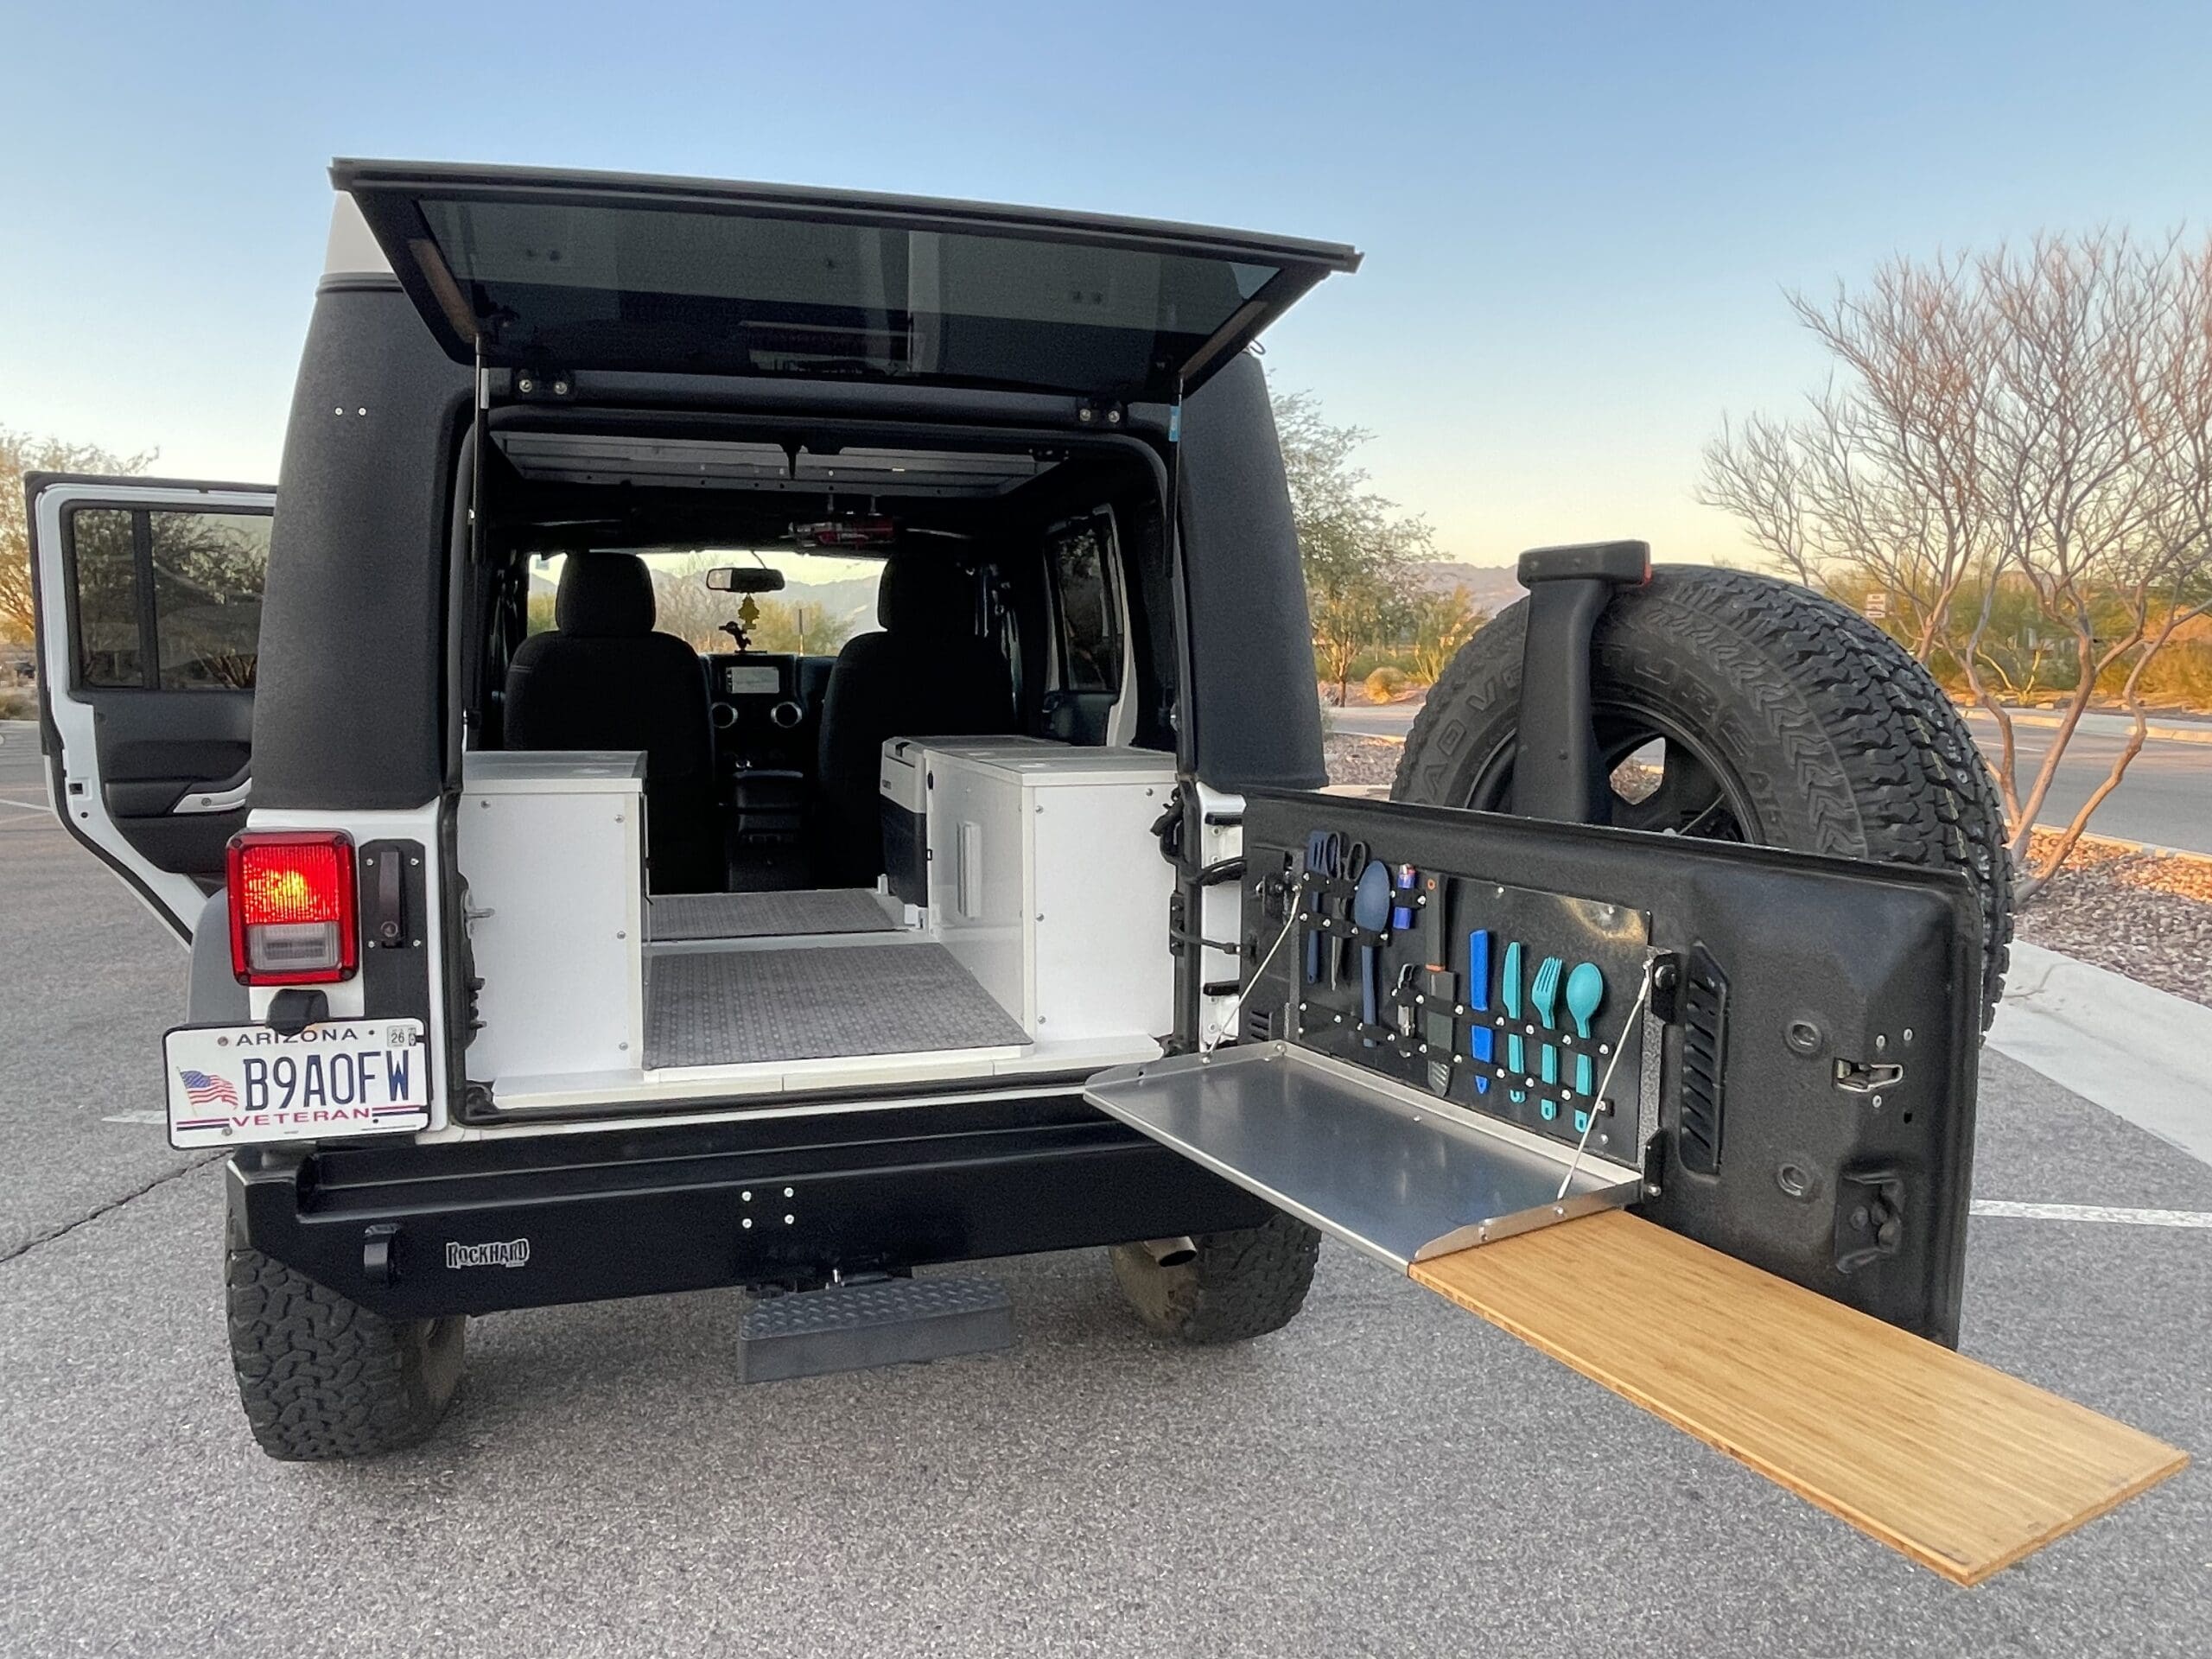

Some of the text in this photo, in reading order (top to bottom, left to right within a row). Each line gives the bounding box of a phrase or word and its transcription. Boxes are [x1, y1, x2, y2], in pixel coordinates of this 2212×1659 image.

[237, 1028, 359, 1046] ARIZONA
[391, 1033, 405, 1044] 26
[232, 1108, 370, 1127] VETERAN
[446, 1238, 530, 1268] ROCKHARD
